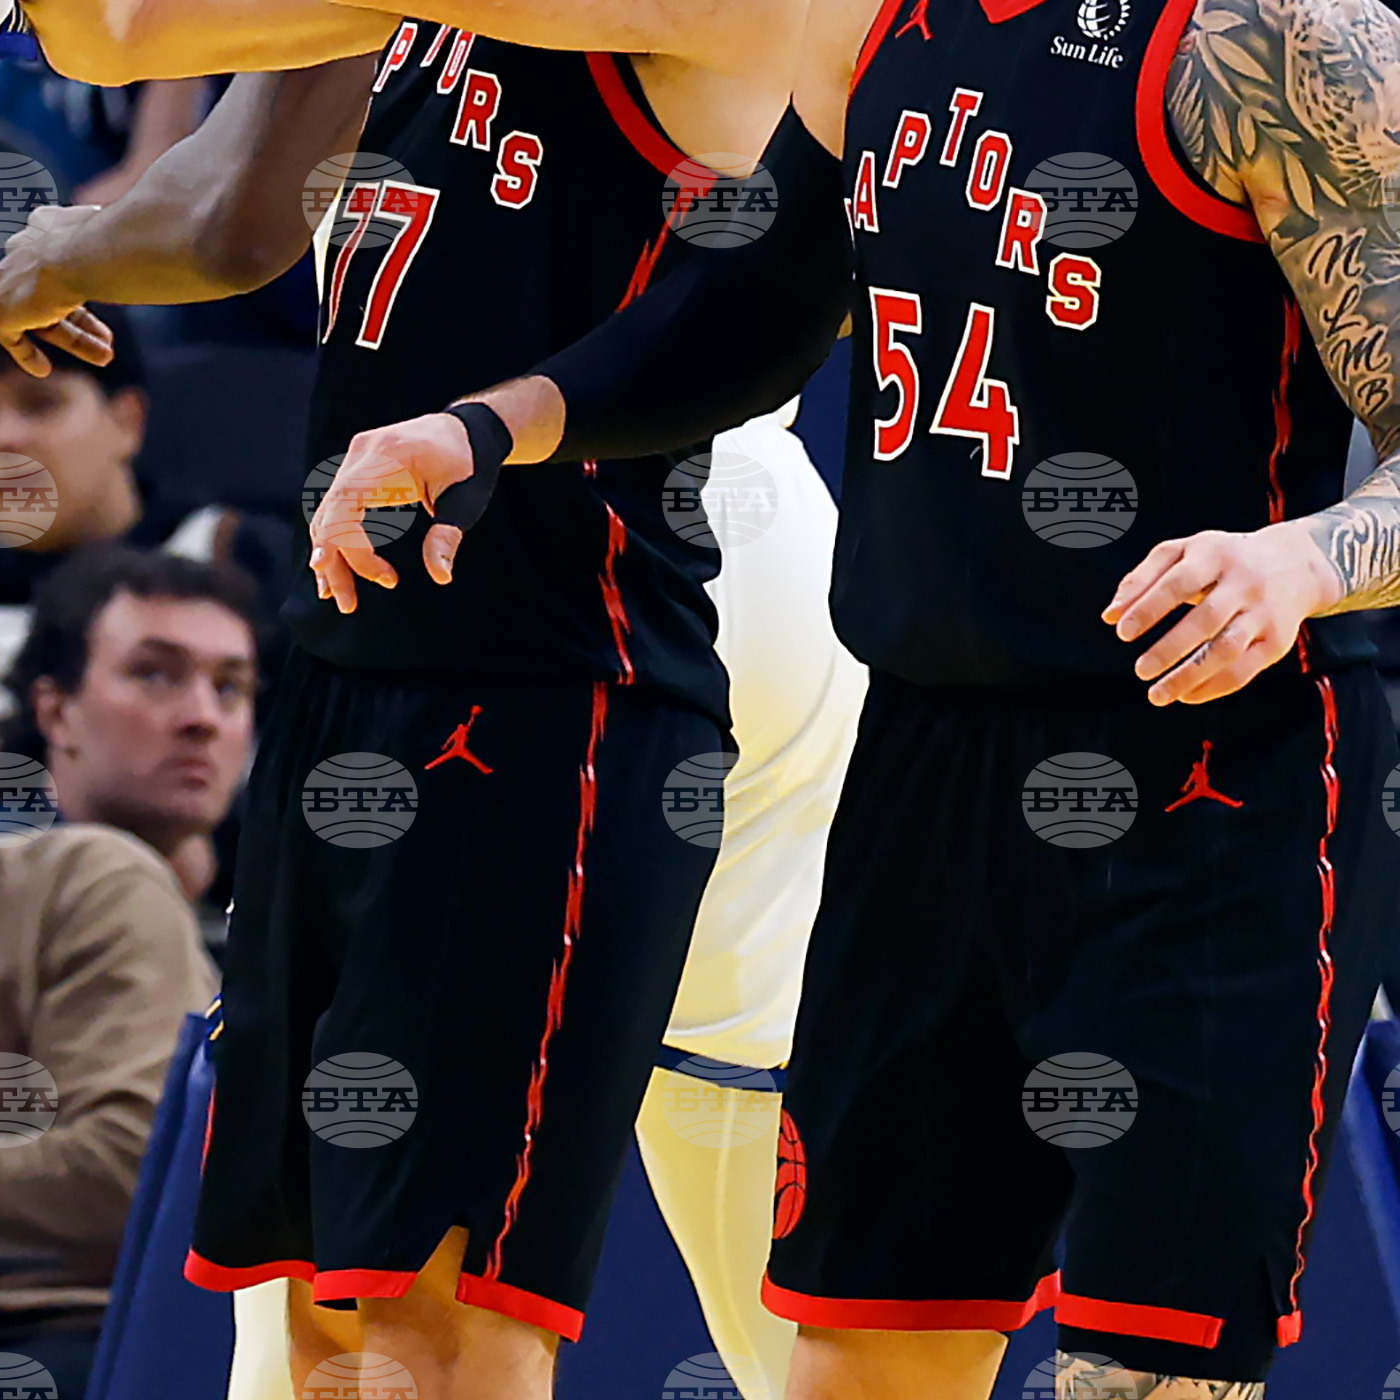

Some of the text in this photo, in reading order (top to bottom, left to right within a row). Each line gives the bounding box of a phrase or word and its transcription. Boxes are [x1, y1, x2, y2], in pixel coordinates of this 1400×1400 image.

[1050, 35, 1124, 69] Sun Life
[322, 180, 440, 350] 77
[844, 88, 1101, 331] APTORS
[869, 286, 1020, 480] 54
